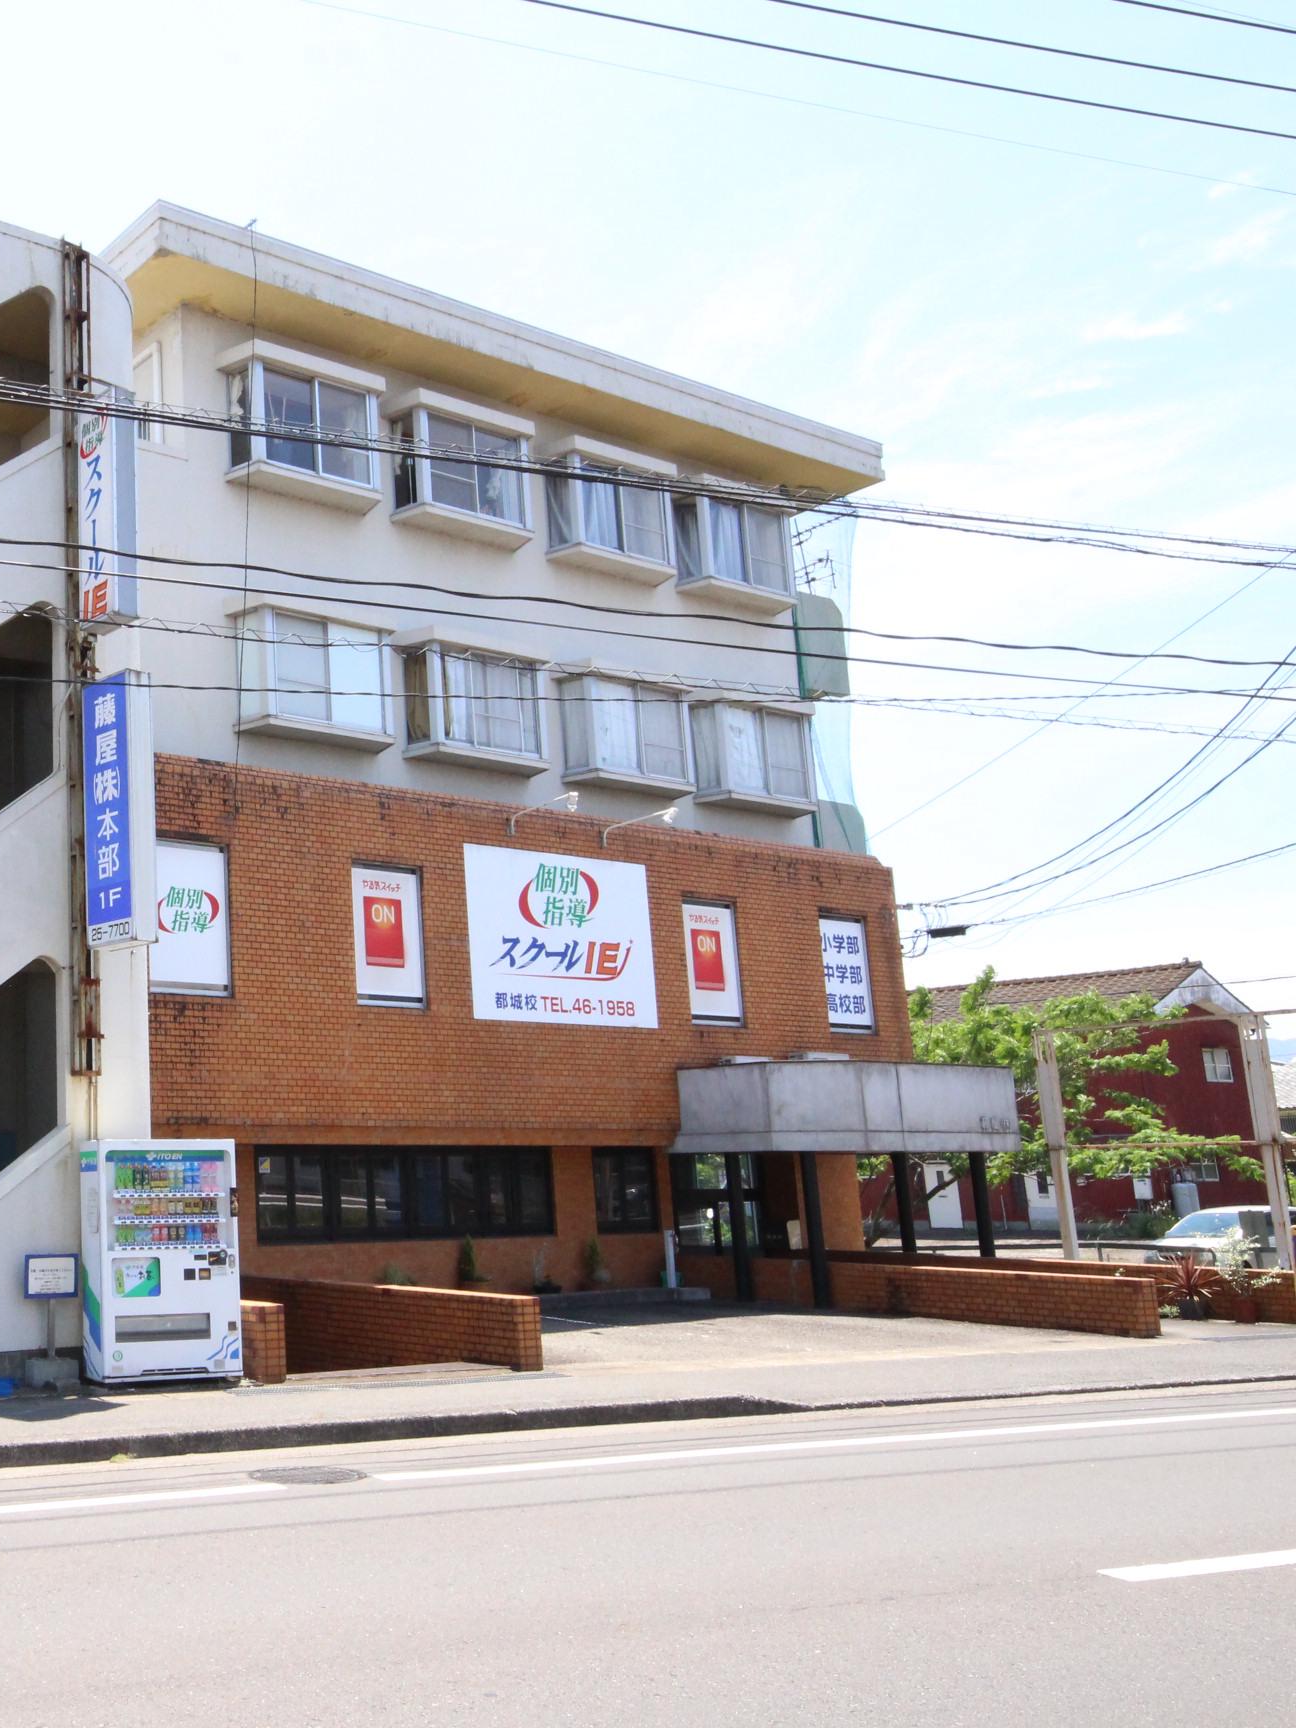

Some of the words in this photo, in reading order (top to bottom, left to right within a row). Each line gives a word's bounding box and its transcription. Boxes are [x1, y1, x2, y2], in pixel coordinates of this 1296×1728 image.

[362, 879, 401, 893] やる気スイッチ
[535, 863, 580, 896] 個別
[98, 887, 122, 909] 1F
[166, 886, 204, 909] 個別
[171, 909, 215, 933] 指導
[372, 904, 395, 924] ON
[542, 896, 595, 929] 指導
[688, 913, 721, 926] やる気スイッチ
[697, 936, 716, 953] ON
[822, 933, 860, 955] 小学部
[489, 935, 621, 976] スクールIE
[823, 963, 863, 985] 中学部
[495, 991, 538, 1011] 都城校
[540, 996, 635, 1017] TEL.46-1958
[826, 993, 866, 1014] 高校部
